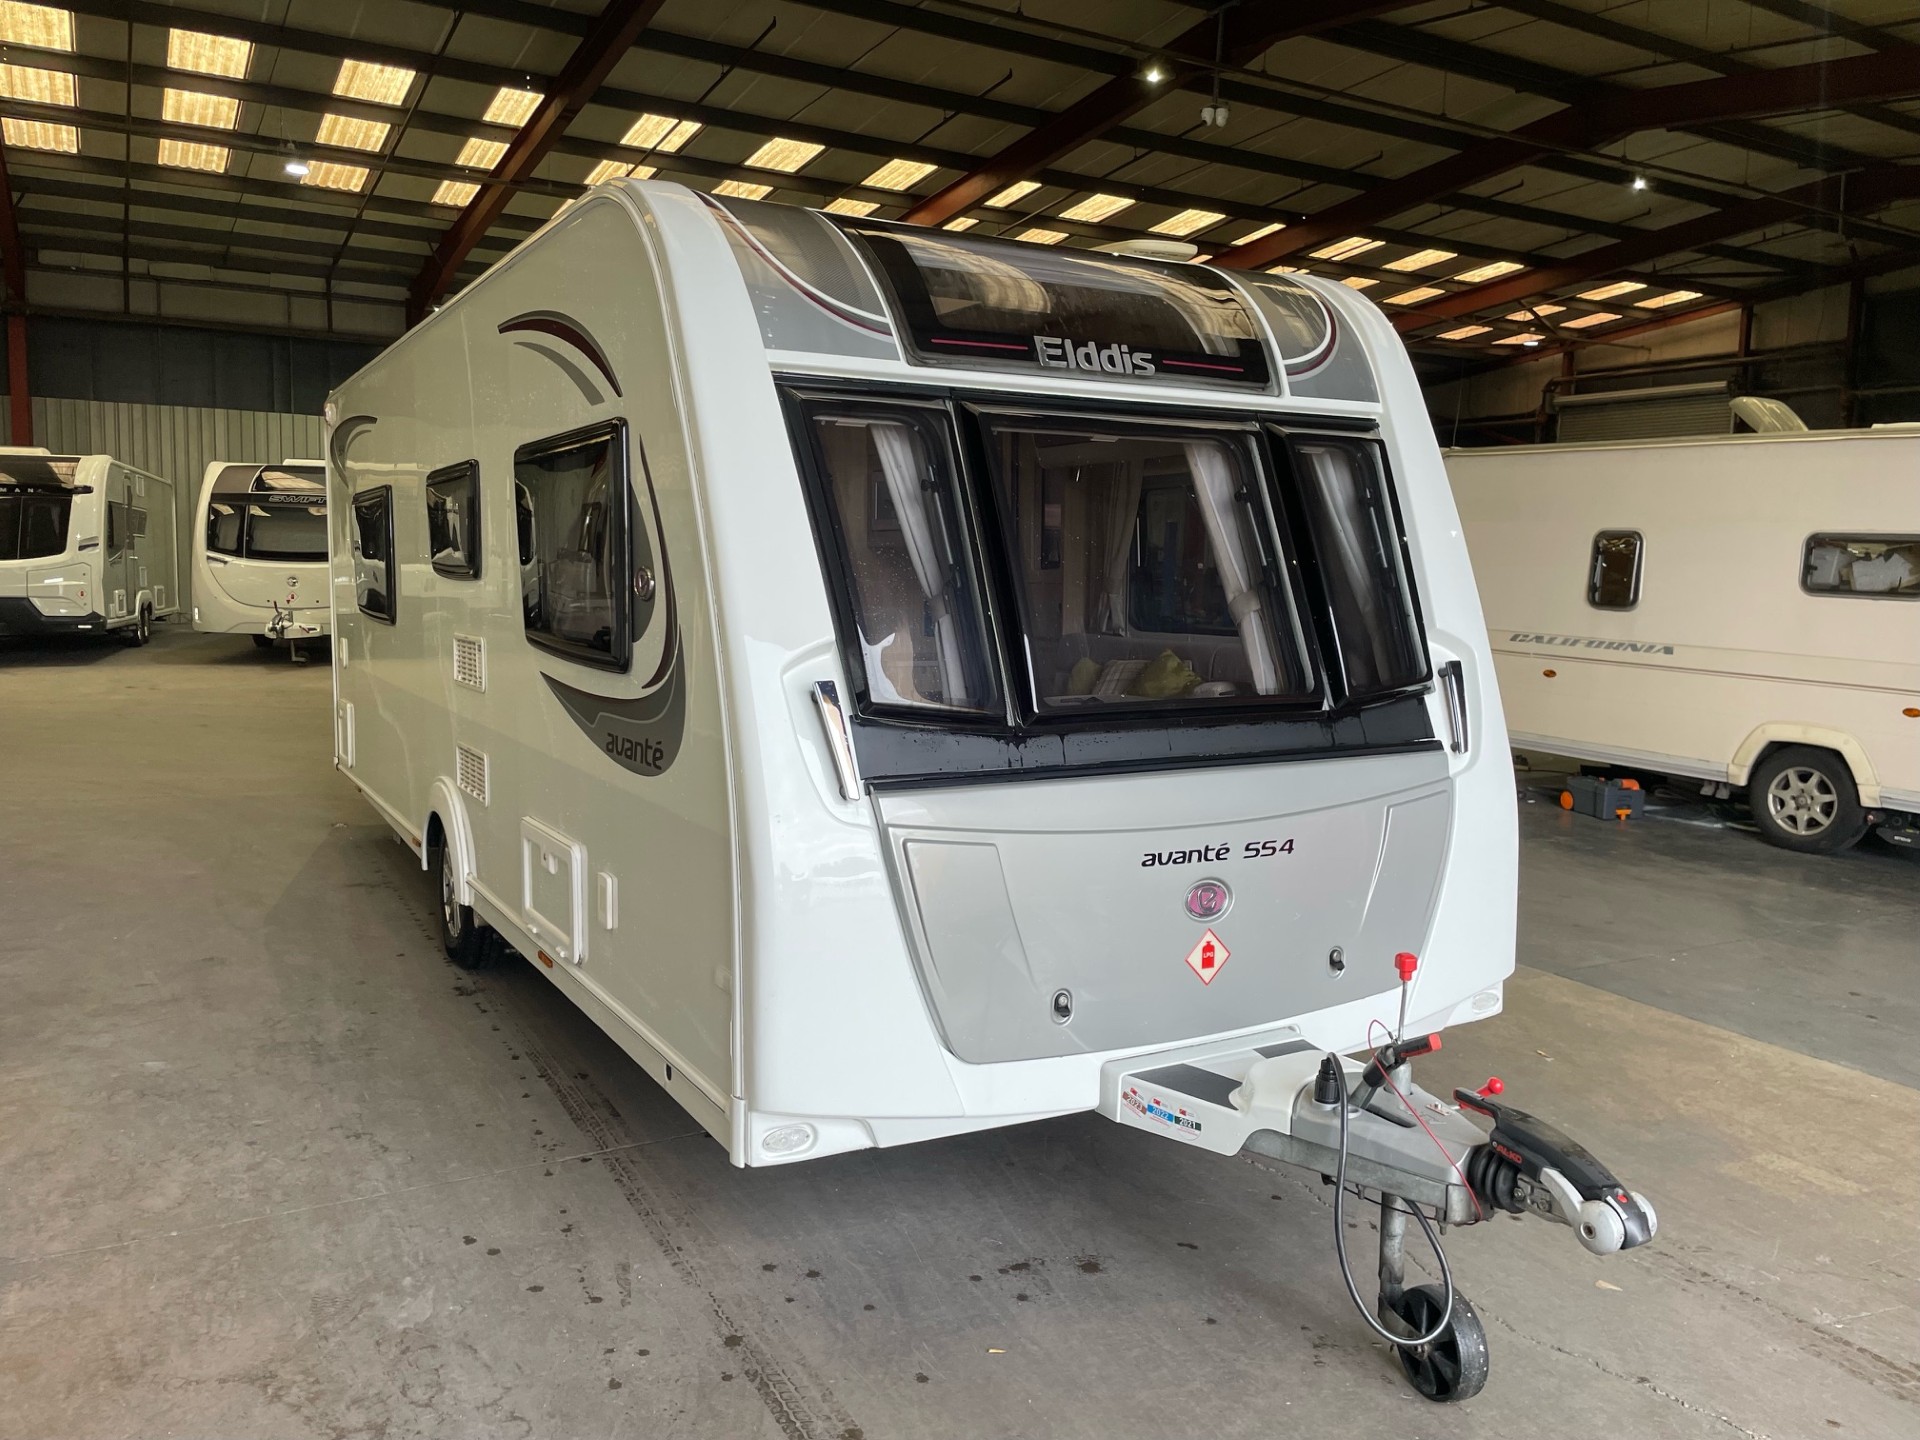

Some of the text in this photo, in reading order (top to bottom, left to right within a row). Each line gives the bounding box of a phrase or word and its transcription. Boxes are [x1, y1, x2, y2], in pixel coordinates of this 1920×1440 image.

[1033, 335, 1155, 376] Elddis
[269, 495, 326, 504] SWIFT
[1509, 633, 1674, 655] CALIFORNIA
[606, 732, 664, 771] avanté
[1141, 842, 1231, 867] avanté
[1152, 1106, 1169, 1120] 2022
[1180, 1117, 1196, 1129] 2021
